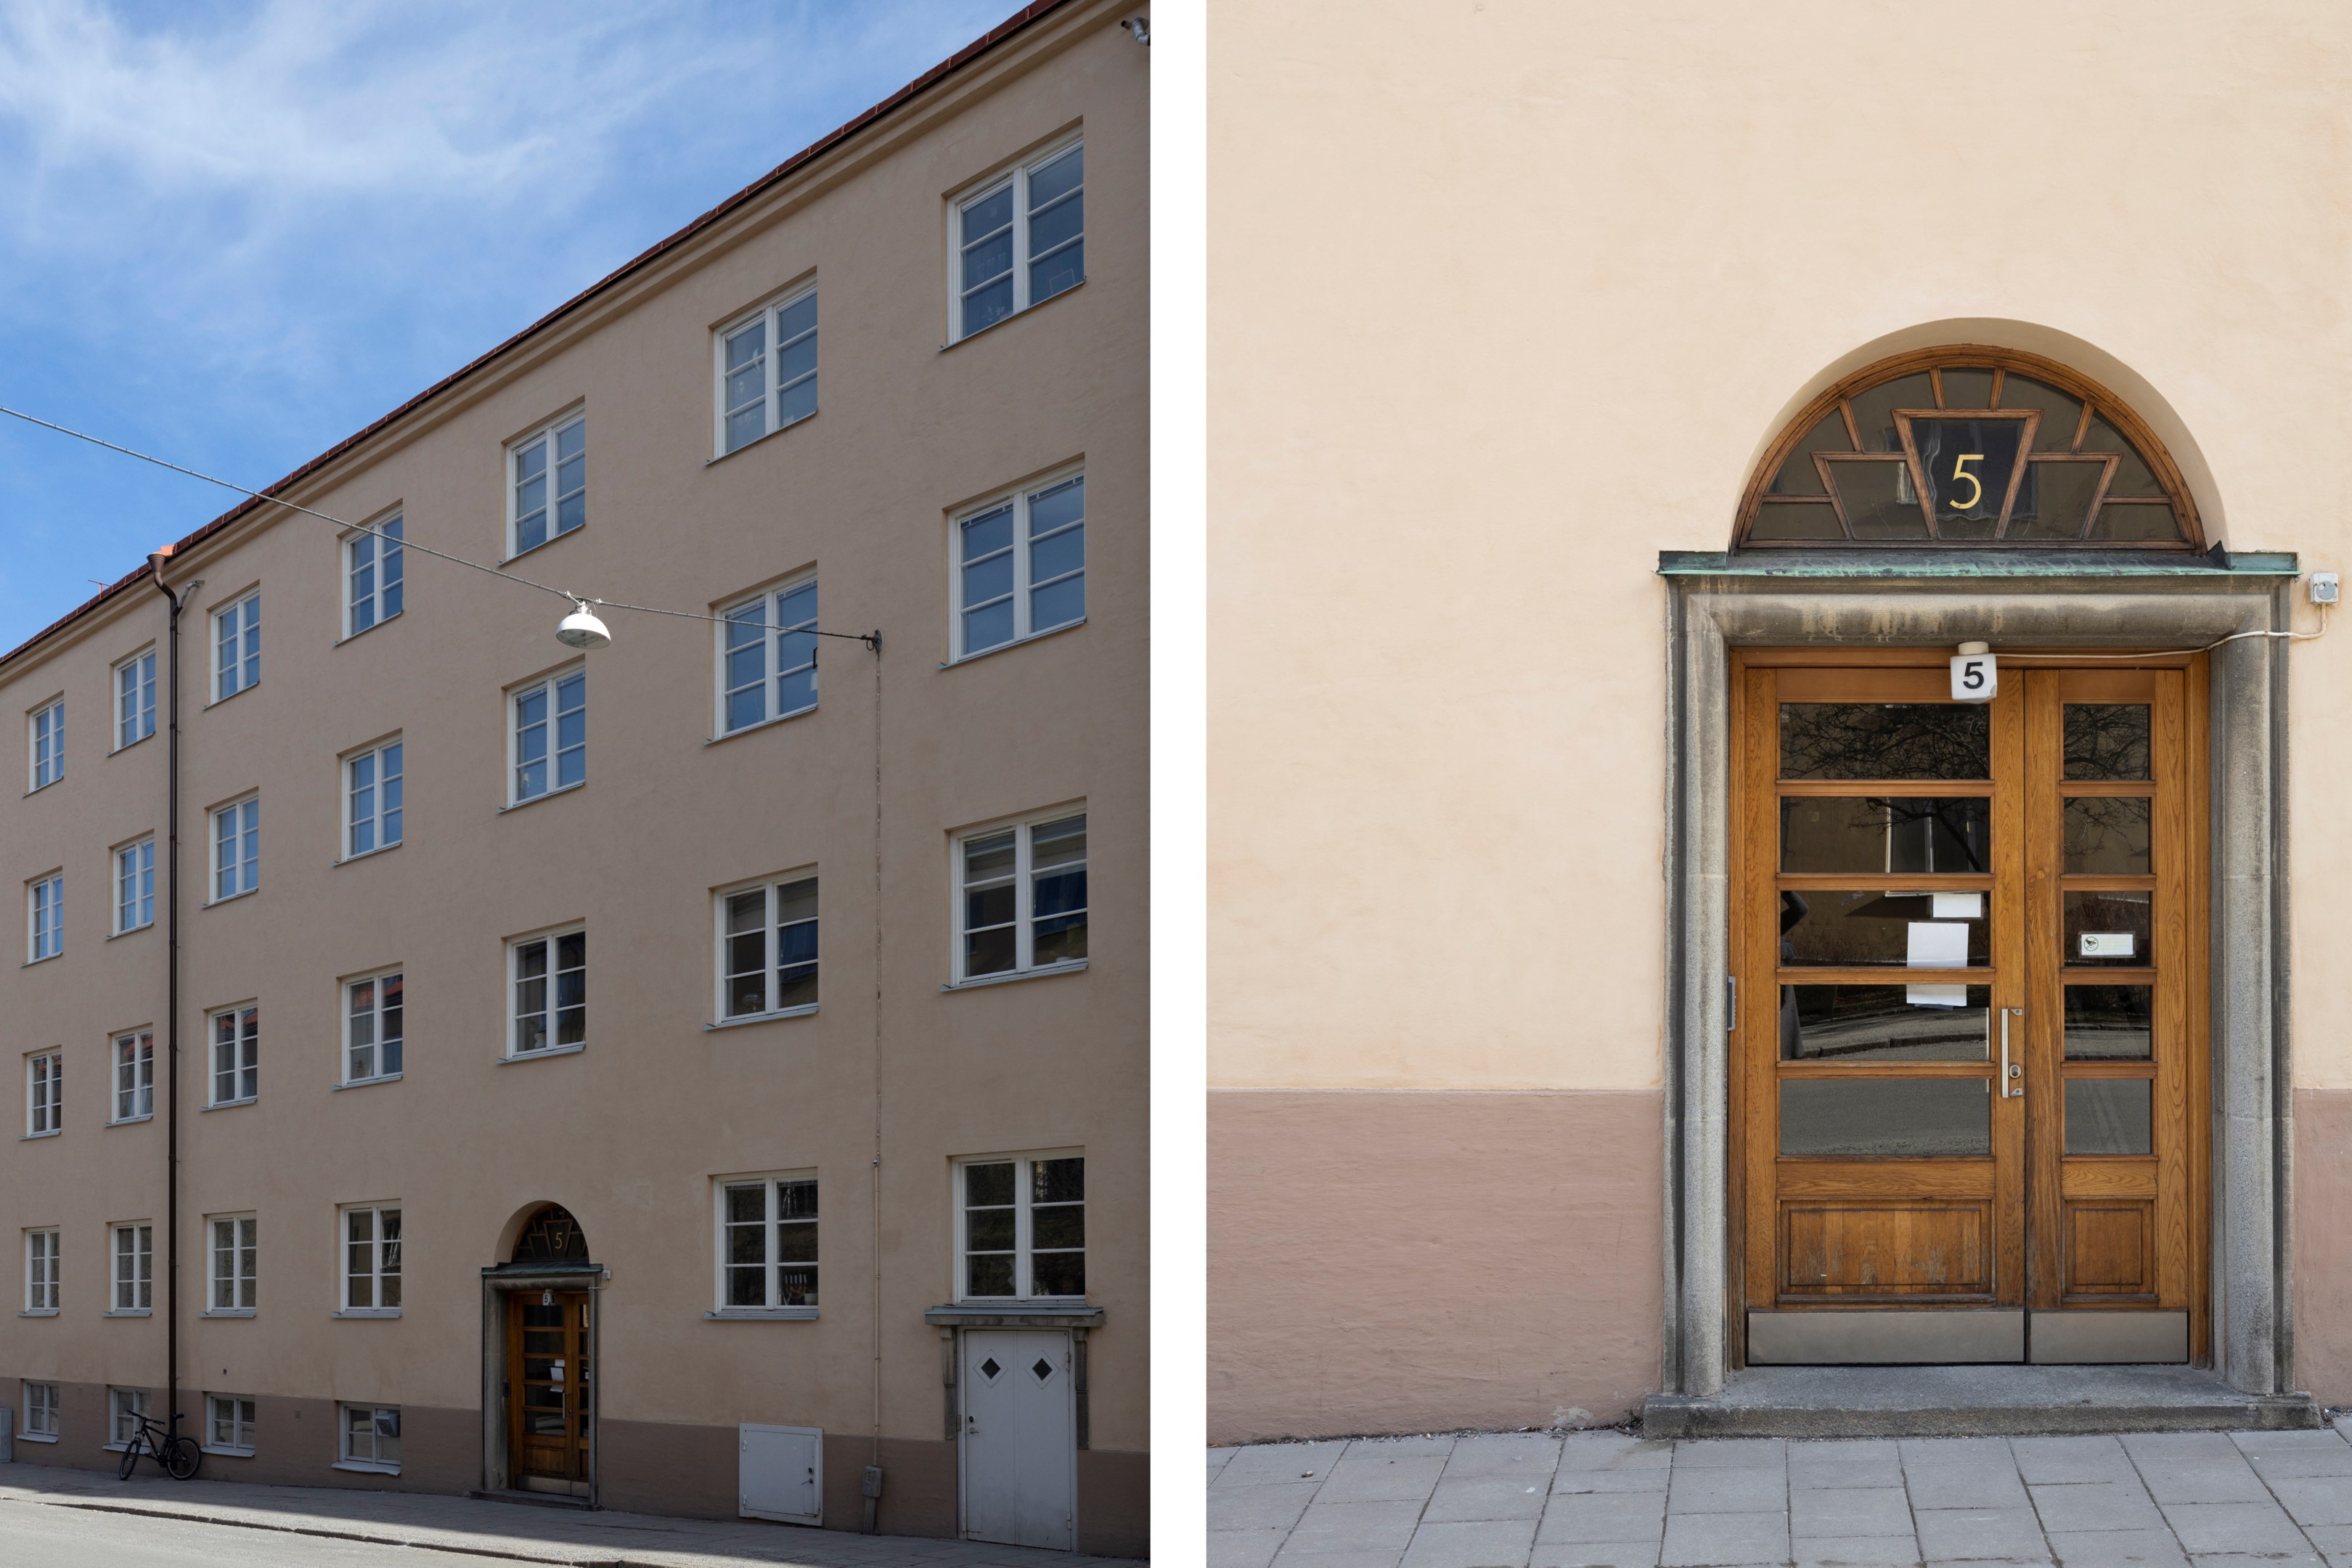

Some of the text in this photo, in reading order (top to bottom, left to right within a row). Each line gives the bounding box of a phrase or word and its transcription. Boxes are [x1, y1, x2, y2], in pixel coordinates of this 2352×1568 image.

[1950, 454, 1984, 510] 5
[1963, 661, 1984, 690] 5
[555, 1232, 563, 1249] 5
[544, 1294, 549, 1303] 5
